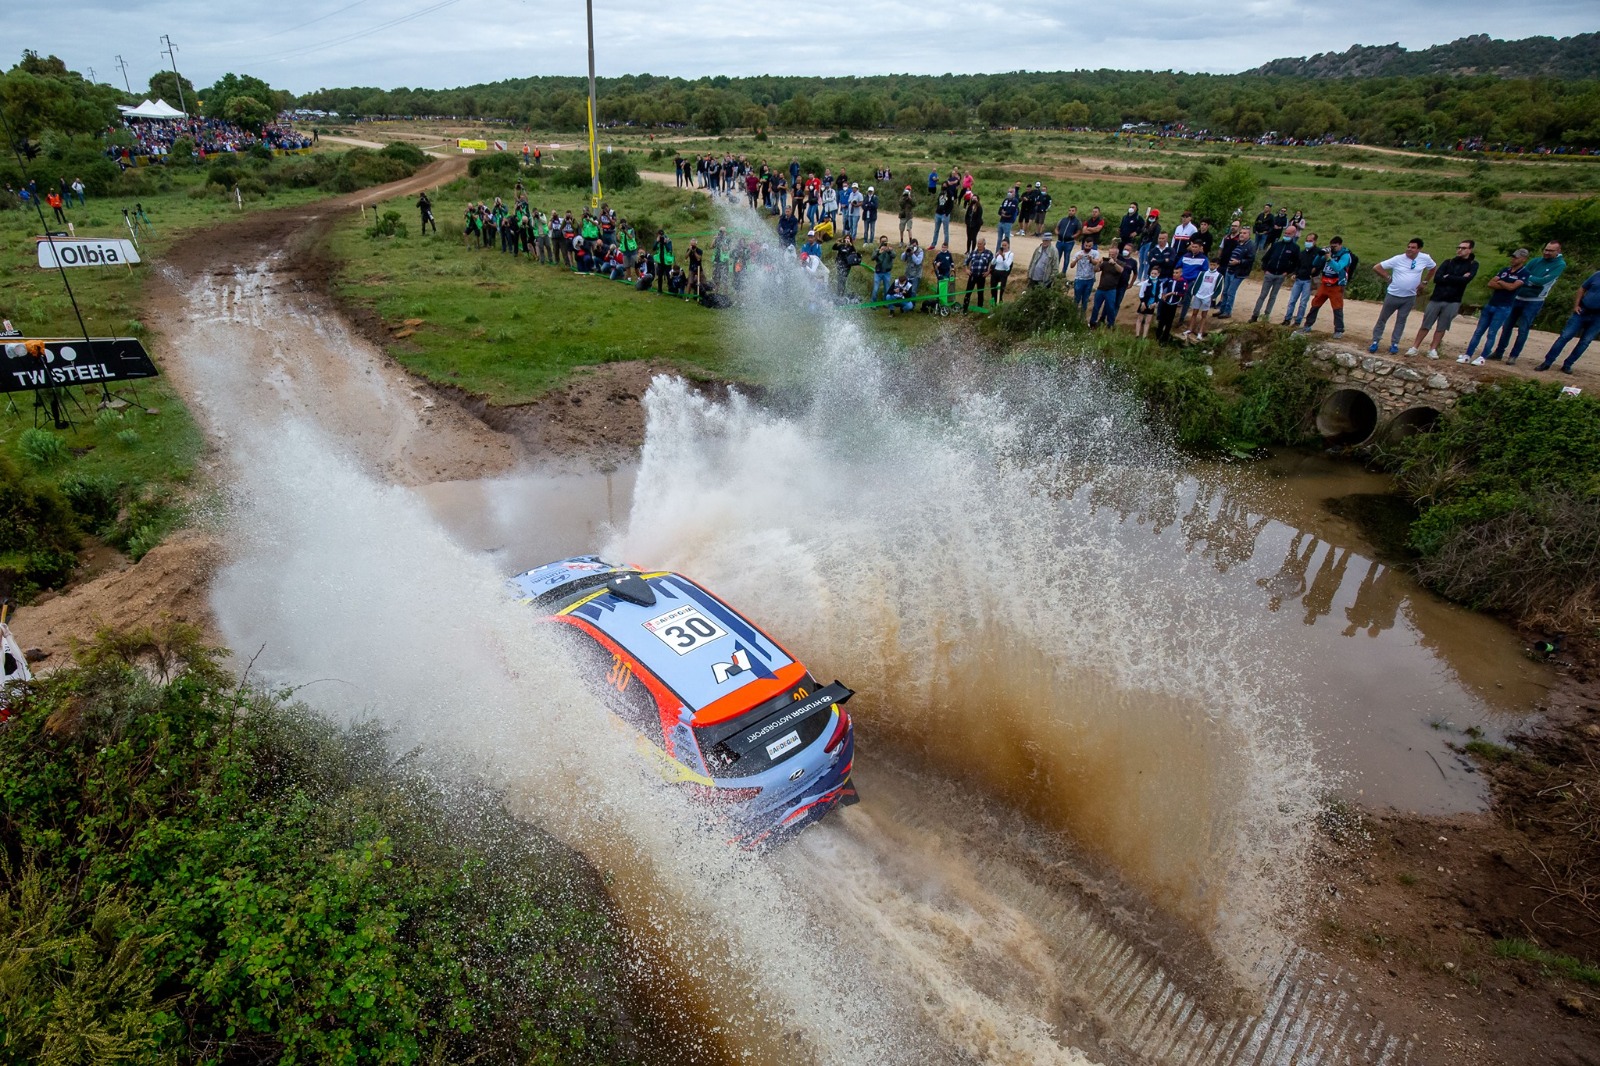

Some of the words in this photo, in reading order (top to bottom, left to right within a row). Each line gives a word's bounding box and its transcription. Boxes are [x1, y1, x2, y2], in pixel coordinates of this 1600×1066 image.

[61, 245, 119, 264] Olbia
[13, 369, 46, 387] TW
[52, 363, 115, 383] STEEL
[665, 617, 716, 648] 30
[606, 653, 632, 692] 30
[791, 700, 822, 718] HYUNDAI
[746, 714, 793, 743] MOTORSPORT
[769, 735, 799, 756] SARDEGNA
